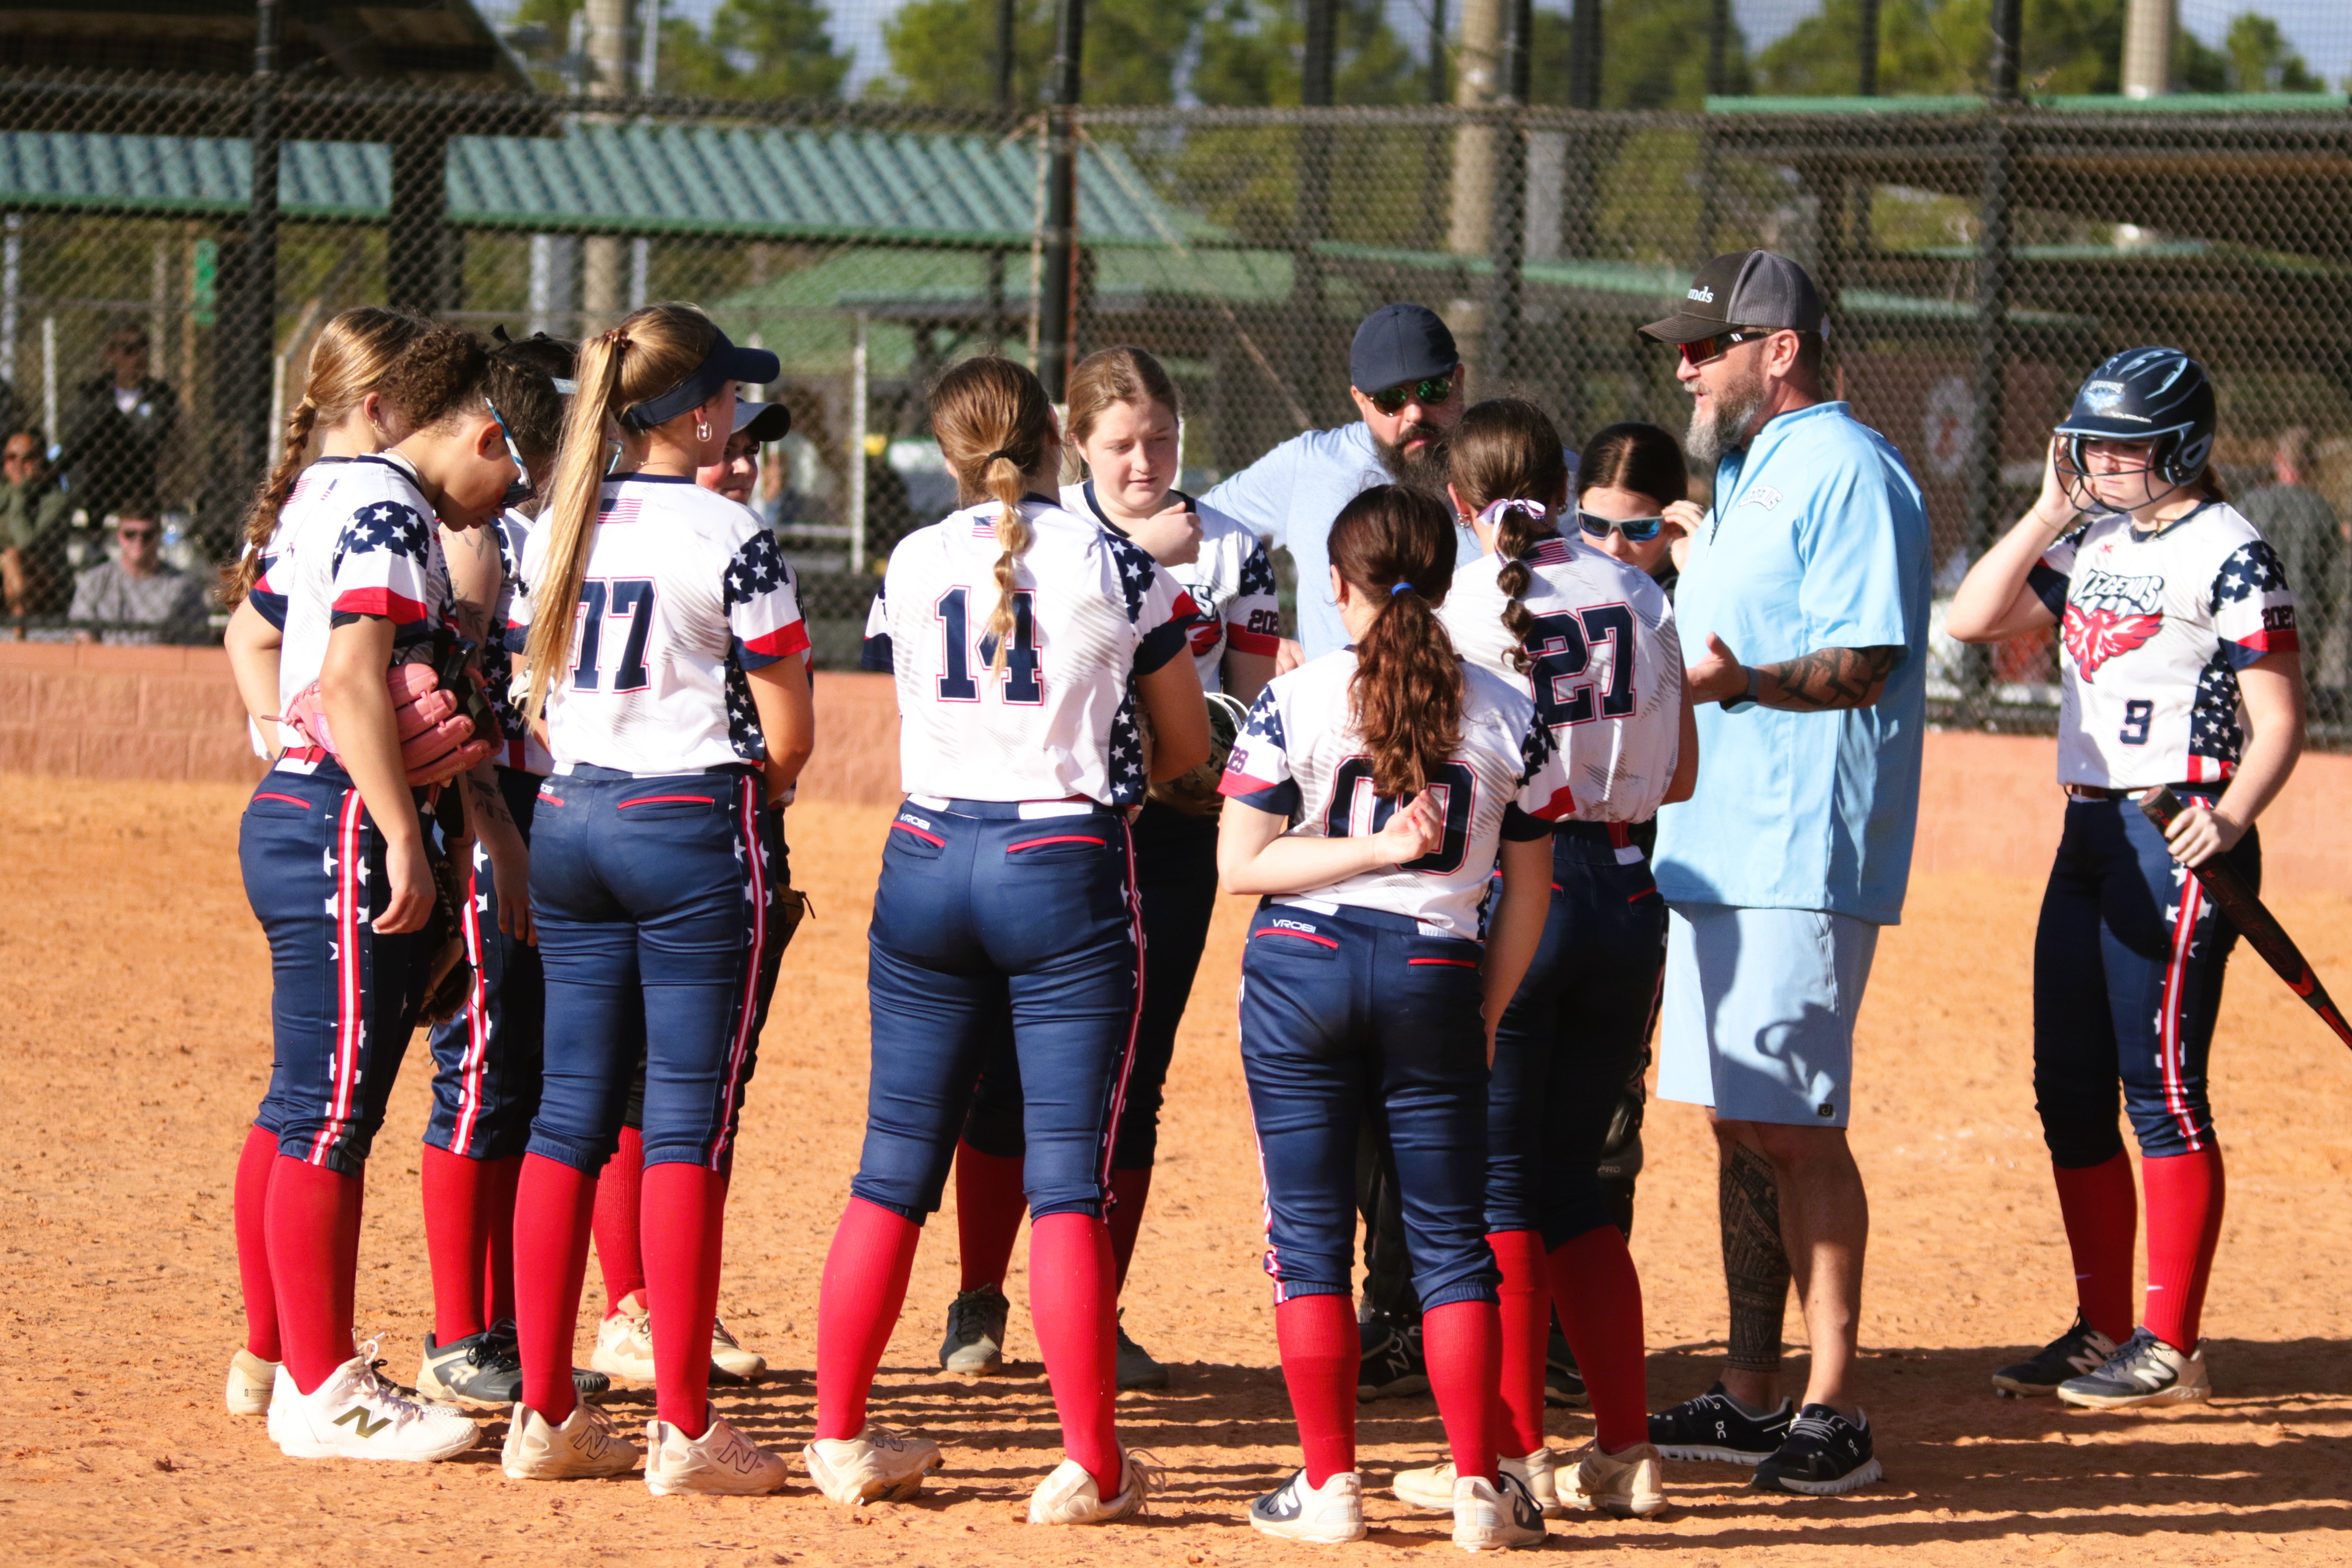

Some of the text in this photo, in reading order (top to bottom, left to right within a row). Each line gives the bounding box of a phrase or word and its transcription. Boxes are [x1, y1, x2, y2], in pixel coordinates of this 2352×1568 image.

[2070, 568, 2164, 613] LEGENDS
[569, 576, 658, 694] 77
[934, 585, 1044, 706] 14
[1245, 609, 1279, 638] 202
[1522, 601, 1636, 729] 27
[2117, 698, 2157, 747] 9
[900, 813, 931, 830] VROBI
[1273, 919, 1316, 933] VROBI
